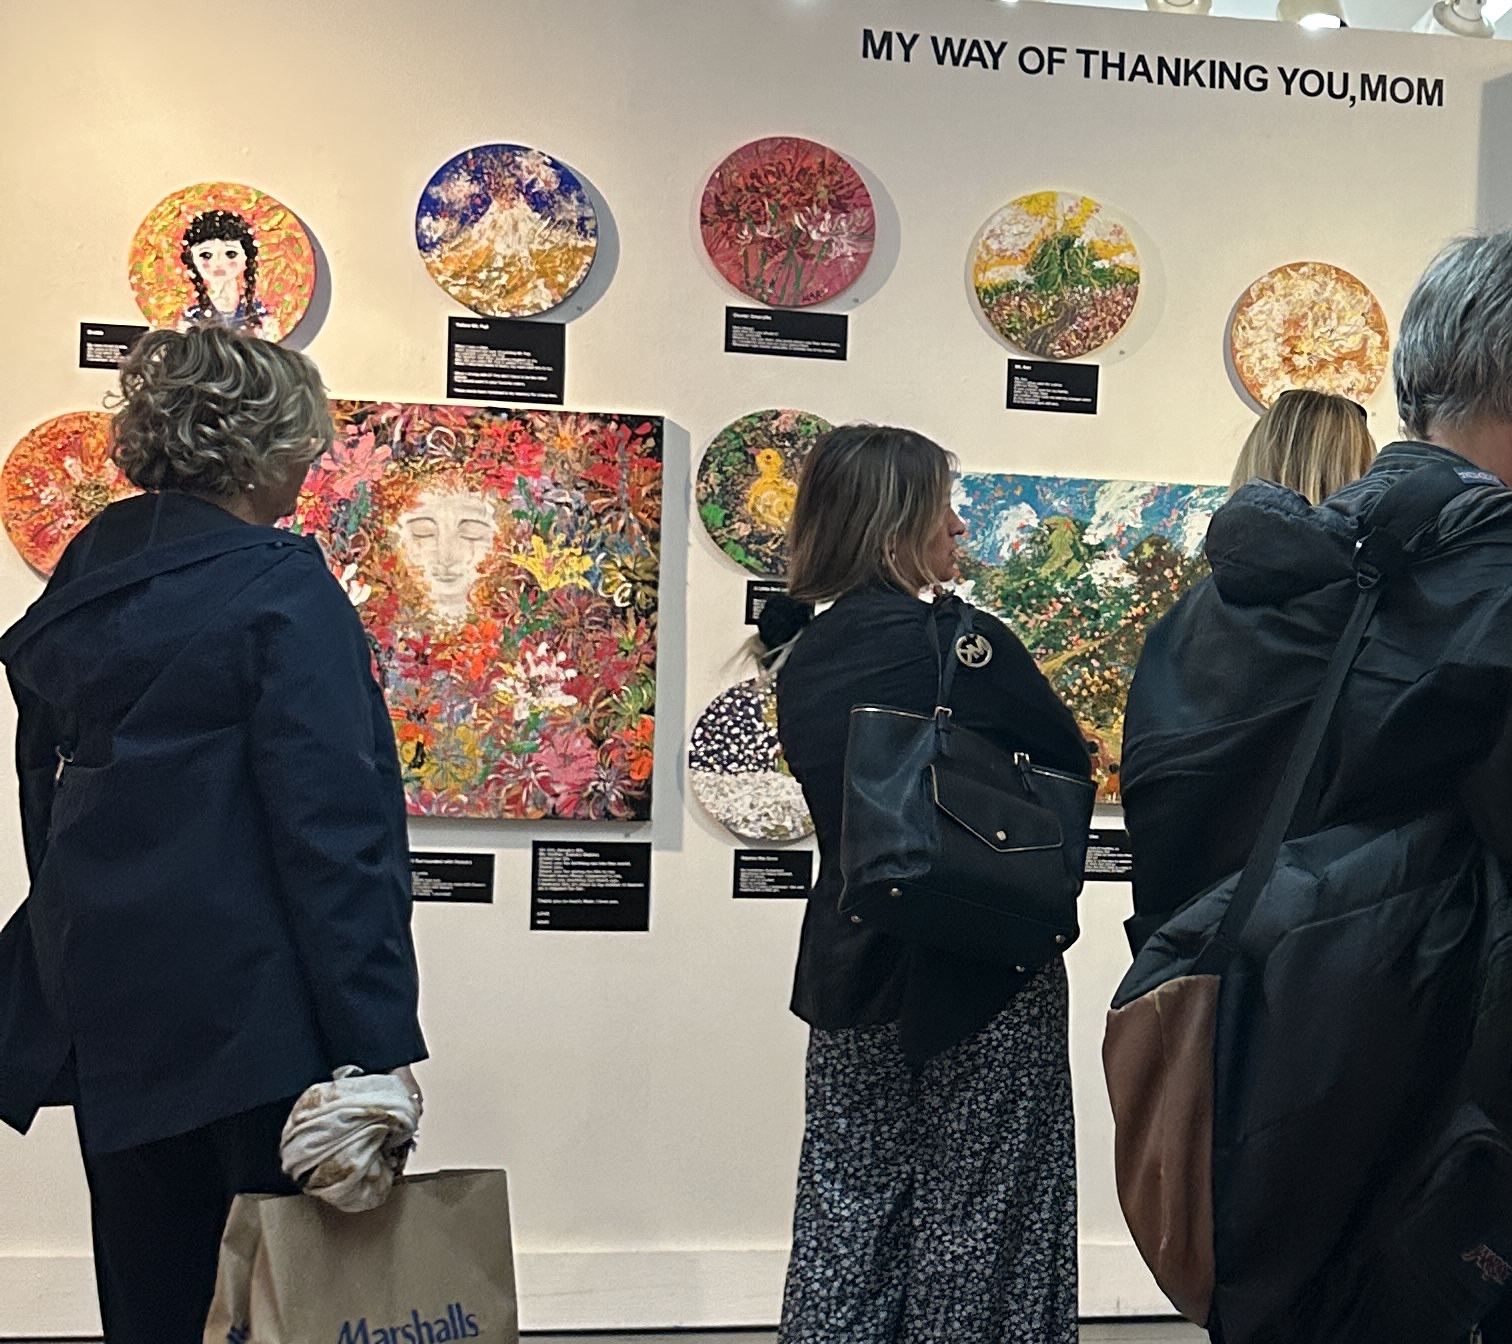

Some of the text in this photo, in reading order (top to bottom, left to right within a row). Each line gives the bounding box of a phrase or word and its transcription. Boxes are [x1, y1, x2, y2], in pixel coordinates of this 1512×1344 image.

[862, 28, 1444, 109] MY WAY OF THANKING YOU,MOM
